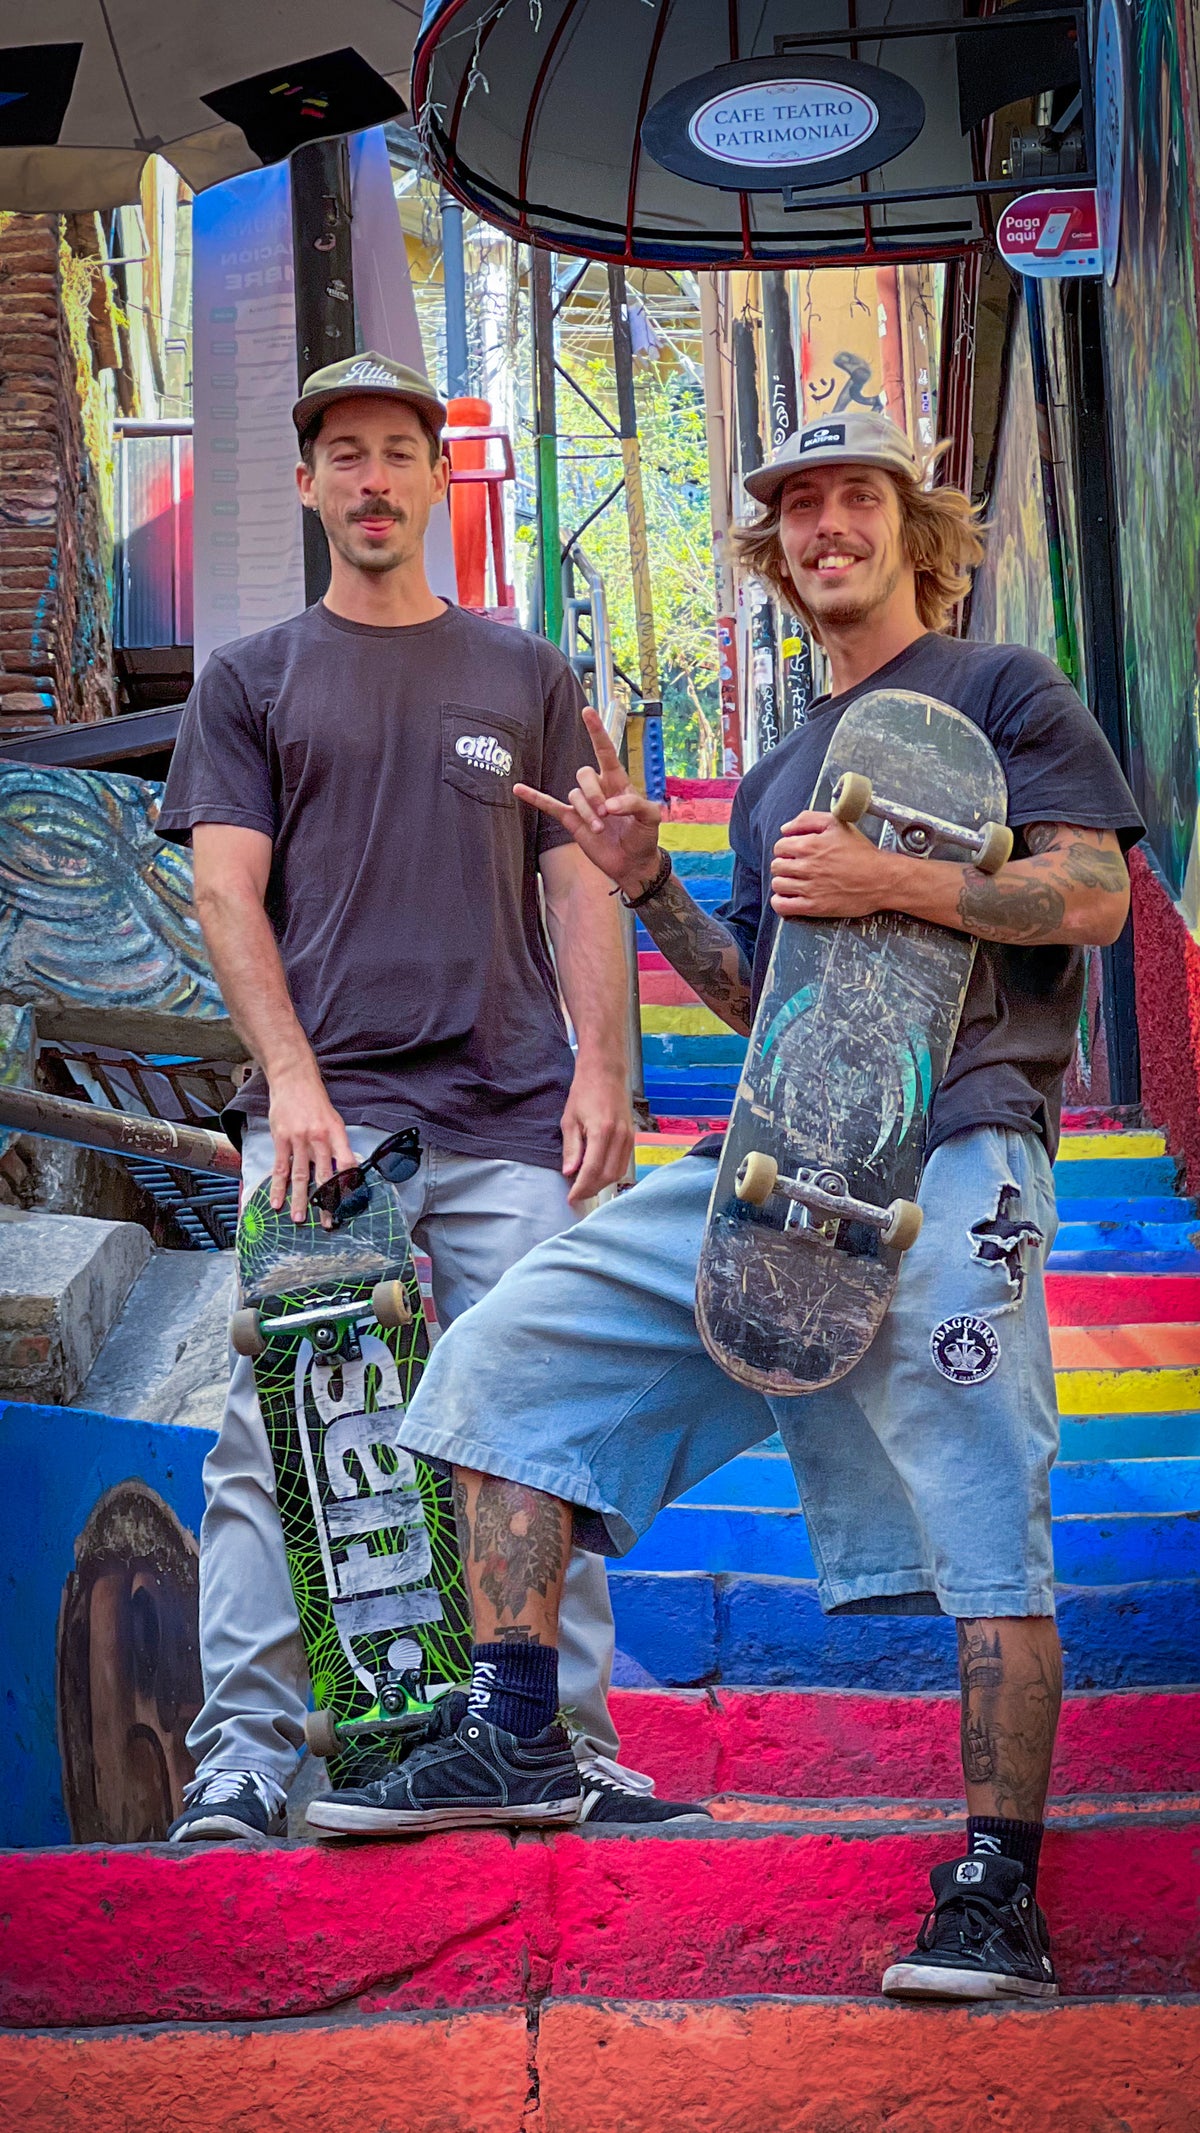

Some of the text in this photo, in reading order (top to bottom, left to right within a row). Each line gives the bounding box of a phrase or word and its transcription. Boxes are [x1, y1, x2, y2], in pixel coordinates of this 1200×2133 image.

[715, 101, 853, 125] CAFE TEATRO
[716, 123, 855, 147] PATRIMONIAL
[1006, 217, 1040, 230] Paga
[1007, 228, 1036, 244] aquí
[338, 361, 401, 384] Atlas
[455, 735, 513, 776] atlas
[934, 1317, 996, 1347] DAGGERS
